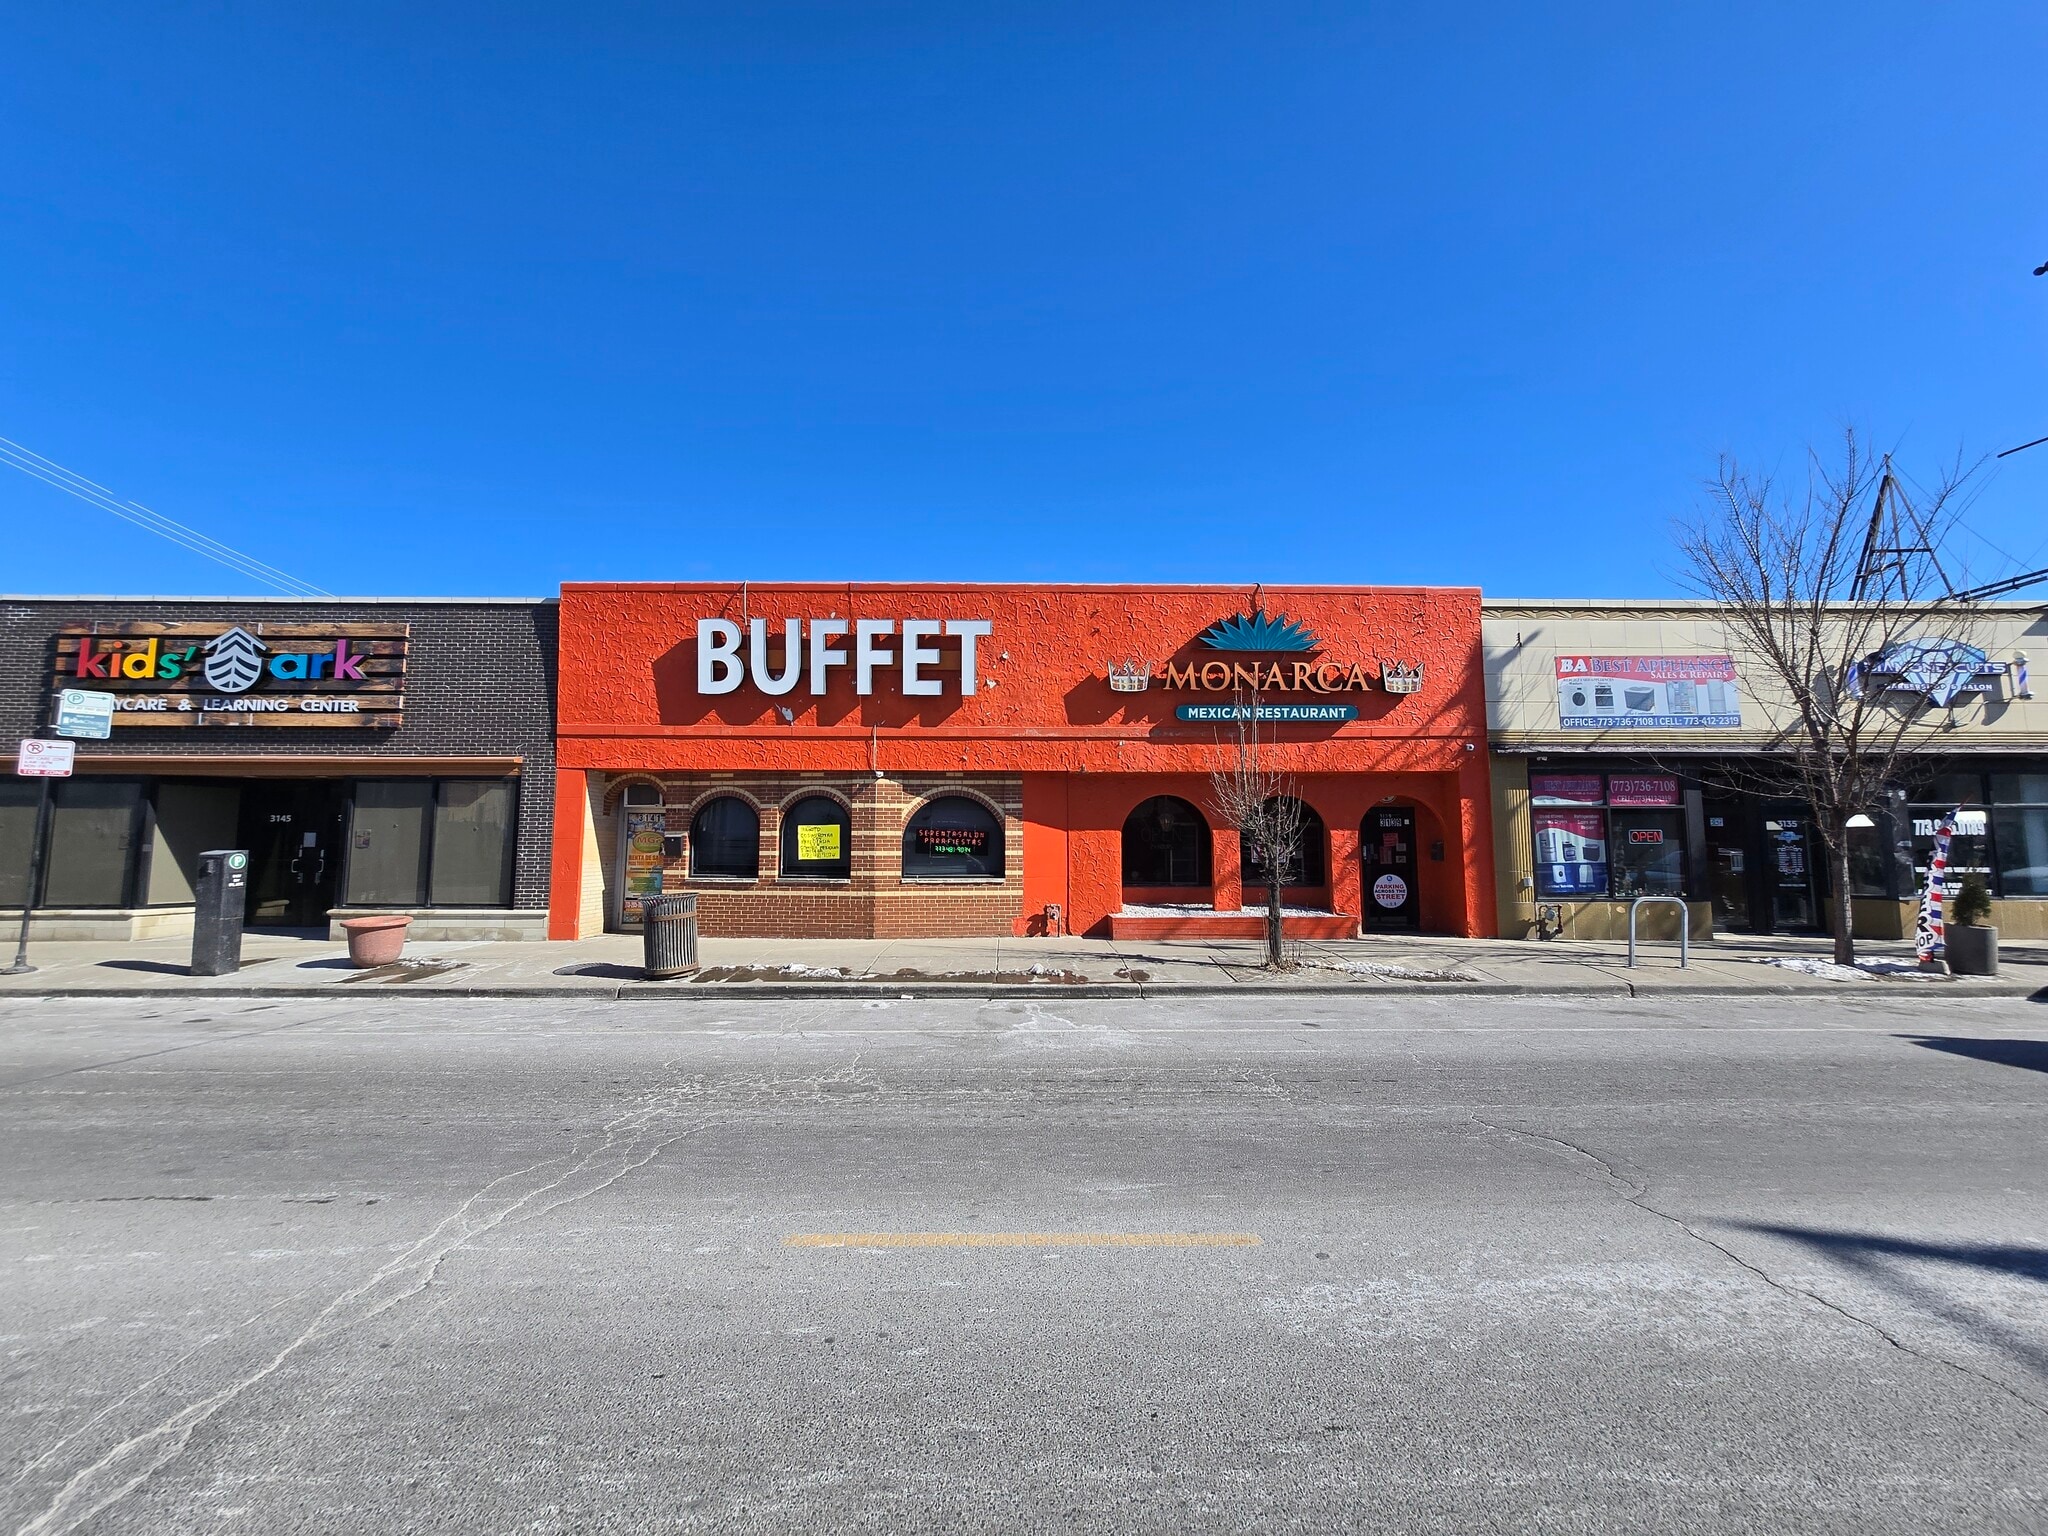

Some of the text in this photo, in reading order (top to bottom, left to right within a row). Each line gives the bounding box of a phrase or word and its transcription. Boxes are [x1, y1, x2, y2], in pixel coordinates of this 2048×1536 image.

[76, 637, 368, 680] kids' ark
[697, 618, 993, 696] BUFFET
[1560, 657, 1732, 673] BA BEST APPLIANCE
[1163, 661, 1373, 695] MONARCA
[1650, 671, 1677, 679] SALES
[1689, 671, 1729, 679] REPAIRS
[112, 698, 168, 712] YCARE
[178, 698, 192, 711] &
[203, 698, 289, 712] LEARNING
[300, 699, 360, 713] CENTER
[1188, 707, 1347, 719] MEXICAN RESTAURANT
[1563, 718, 1596, 727] OFFICE:
[1597, 717, 1654, 727] 773-736-7108
[1659, 717, 1683, 726] CELL:
[1683, 717, 1739, 726] 773-412-2319
[1610, 780, 1676, 793] (773)736-7108
[269, 814, 292, 822] 3145
[1777, 820, 1798, 828] 3135
[1631, 831, 1662, 843] OPEN
